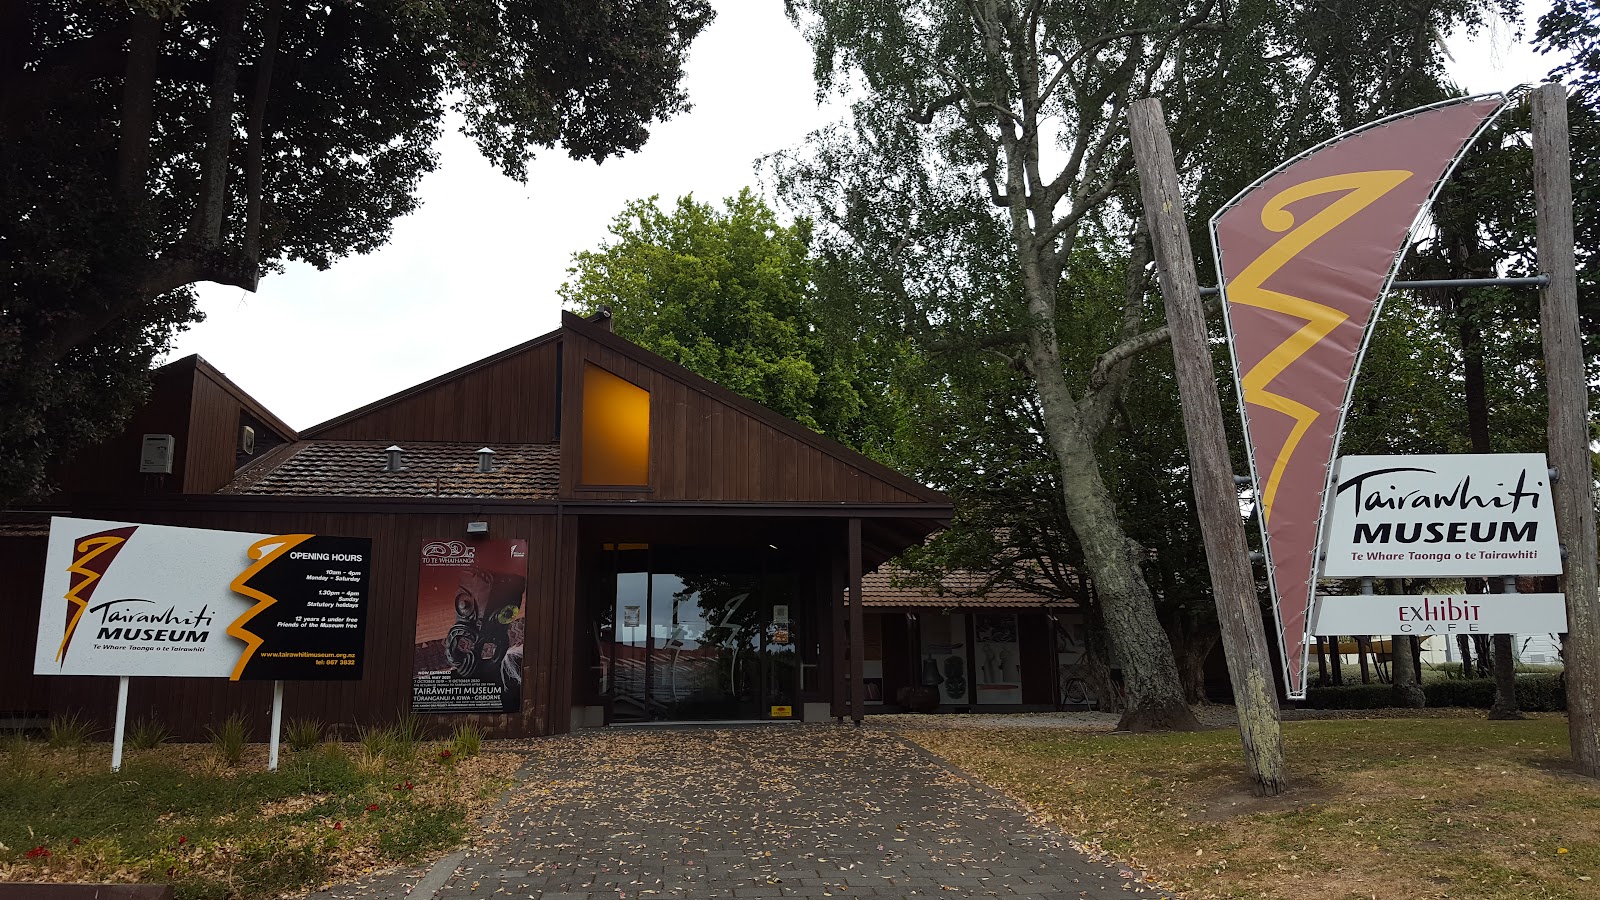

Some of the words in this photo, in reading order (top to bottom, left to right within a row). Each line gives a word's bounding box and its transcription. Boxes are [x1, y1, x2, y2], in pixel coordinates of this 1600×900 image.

[1337, 467, 1543, 518] Tairawhiti
[1353, 521, 1538, 544] MUSEUM
[289, 551, 330, 561] OPENING
[331, 553, 363, 562] HOURS
[1351, 551, 1364, 561] Te
[1366, 551, 1405, 561] Whare
[1408, 551, 1451, 563] Taonga
[1465, 552, 1477, 560] te
[1479, 550, 1538, 560] Tairawhiti
[305, 574, 329, 582] Monday
[335, 601, 359, 609] holidays
[89, 598, 216, 628] Tairawhiti
[1400, 623, 1480, 632] CAFE
[96, 627, 210, 642] MUSEUM
[463, 686, 502, 695] MUSEUM
